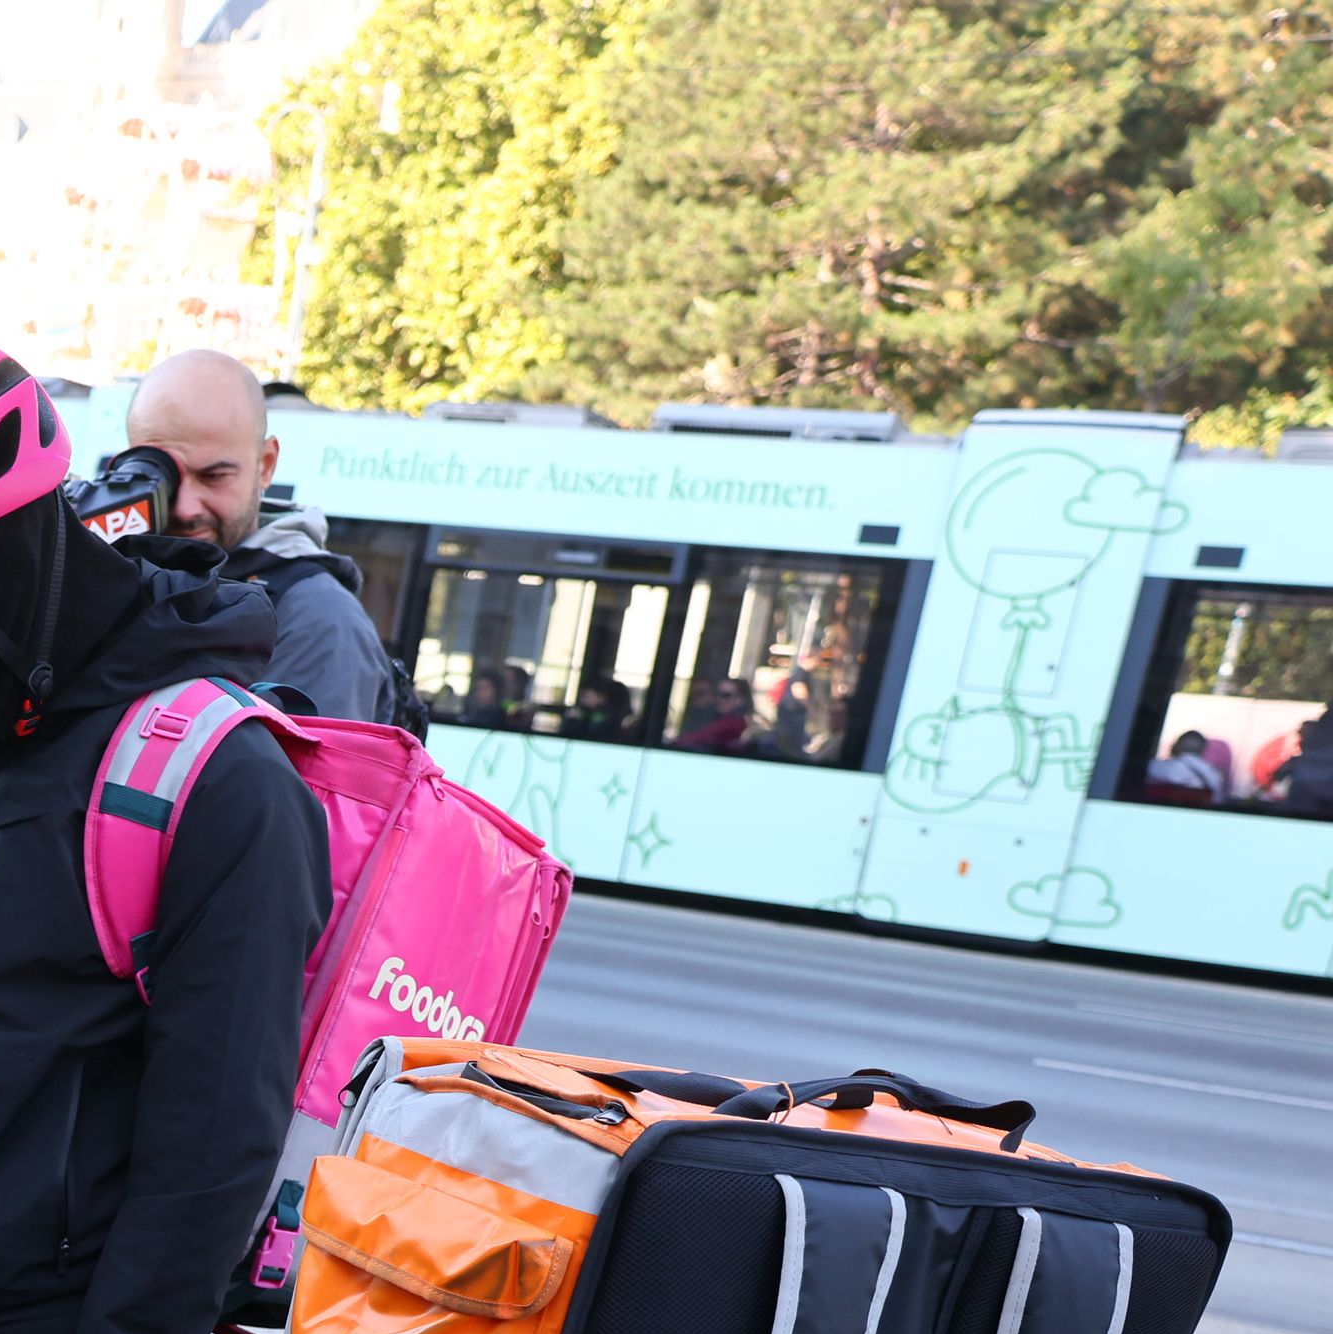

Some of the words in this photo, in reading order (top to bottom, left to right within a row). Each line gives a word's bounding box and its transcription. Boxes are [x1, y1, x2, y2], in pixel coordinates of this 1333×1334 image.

[320, 445, 466, 486] Pünktlich
[475, 464, 532, 490] zur
[537, 459, 660, 498] Auszeit
[667, 463, 839, 511] kommen.
